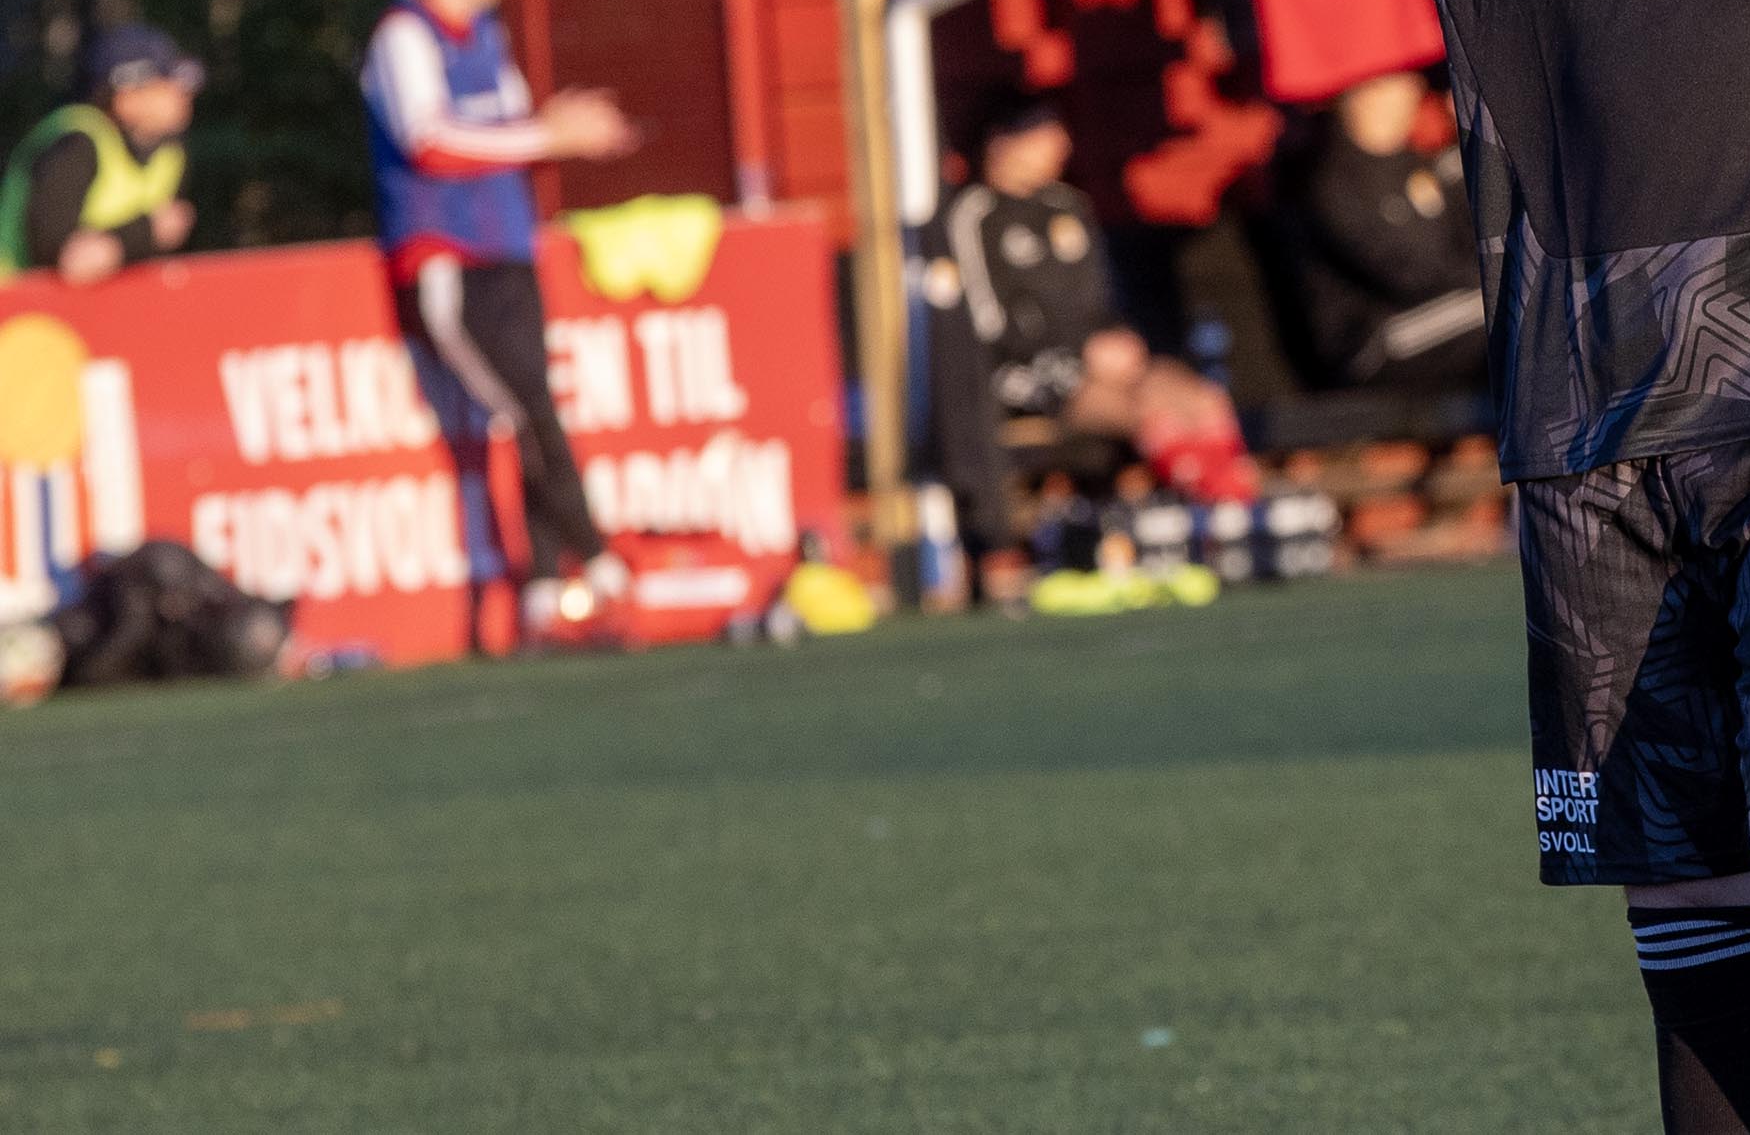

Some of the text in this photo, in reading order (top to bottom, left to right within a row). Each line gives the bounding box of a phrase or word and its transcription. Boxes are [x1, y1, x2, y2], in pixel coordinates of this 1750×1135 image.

[637, 309, 745, 424] TIL
[1535, 768, 1598, 798] INTER
[1537, 796, 1599, 824] SPORT
